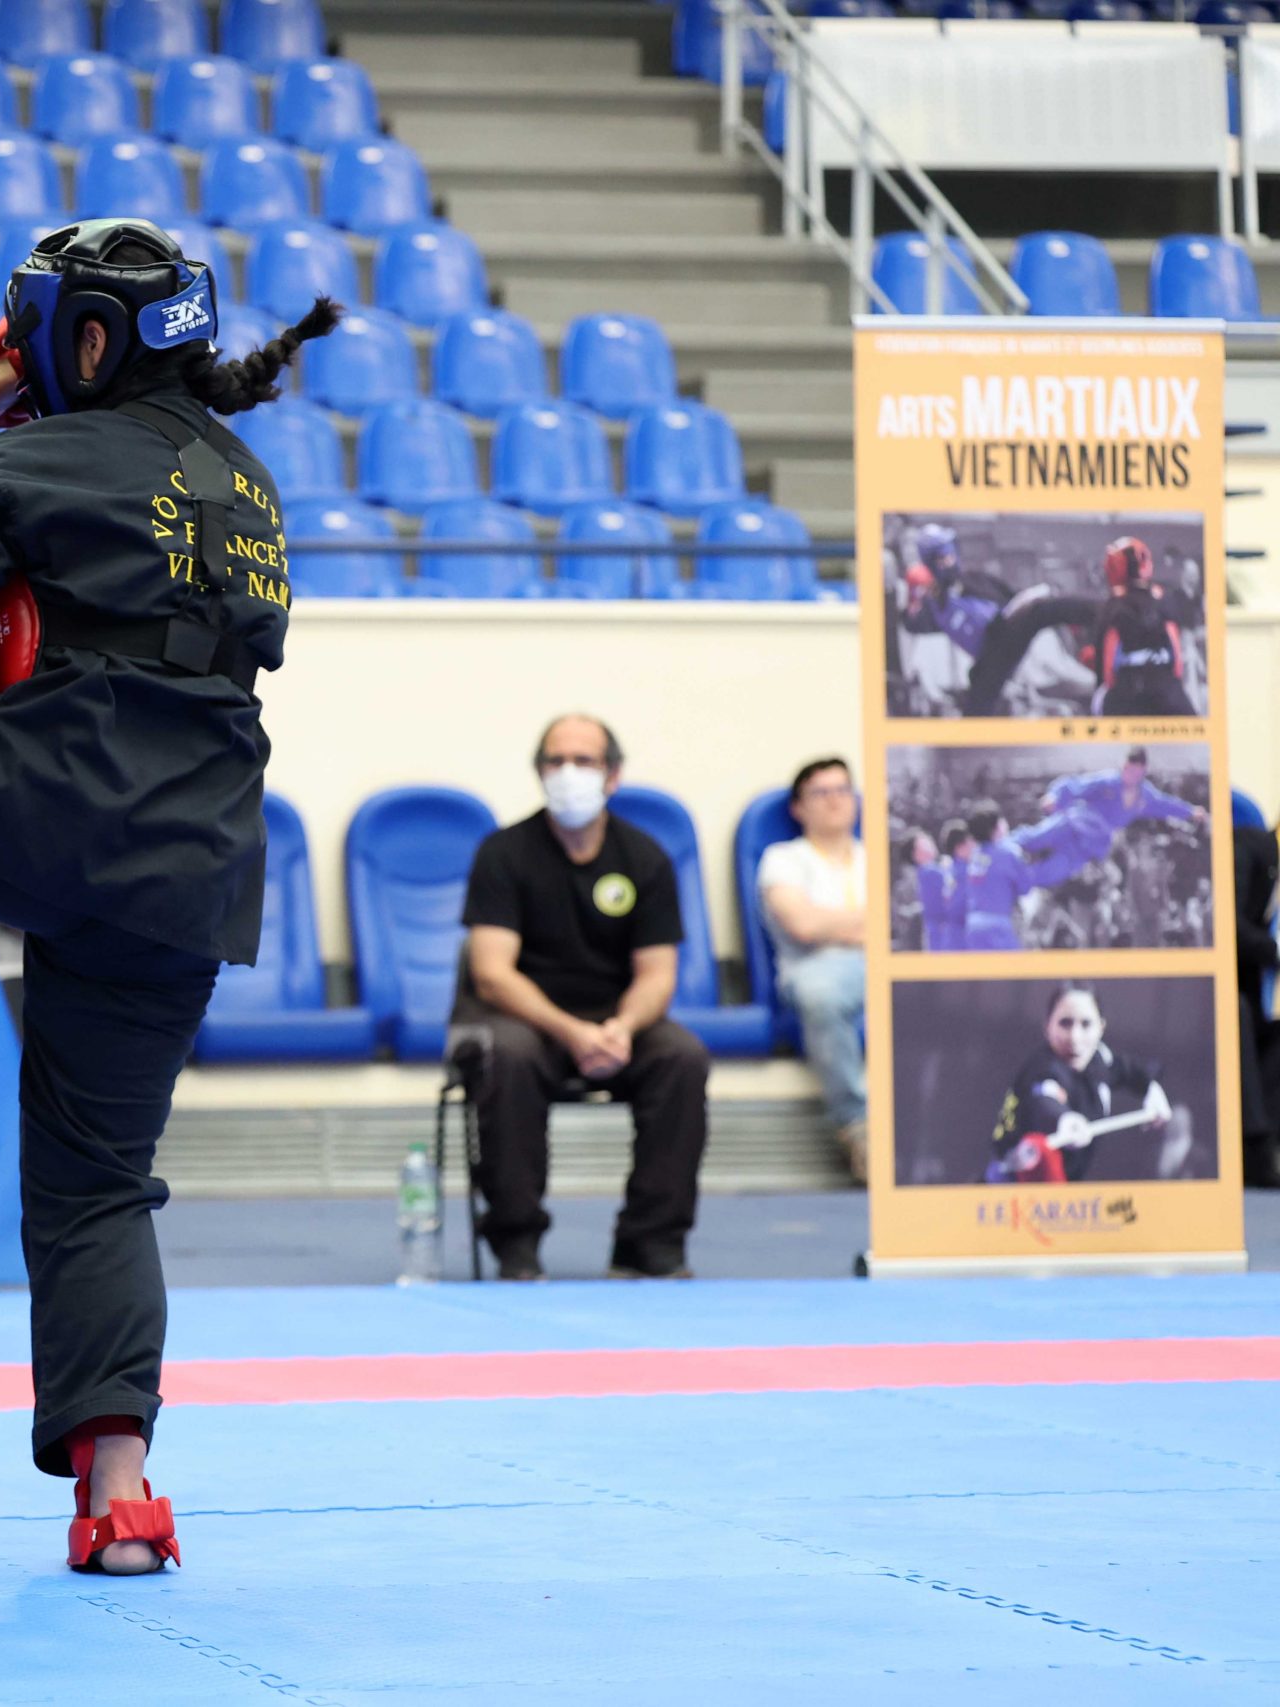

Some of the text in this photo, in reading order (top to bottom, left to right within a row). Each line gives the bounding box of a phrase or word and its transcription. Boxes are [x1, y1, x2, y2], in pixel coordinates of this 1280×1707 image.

[877, 375, 1201, 440] ARTS MARTIAUX
[945, 440, 1191, 488] VIETNAMIENS
